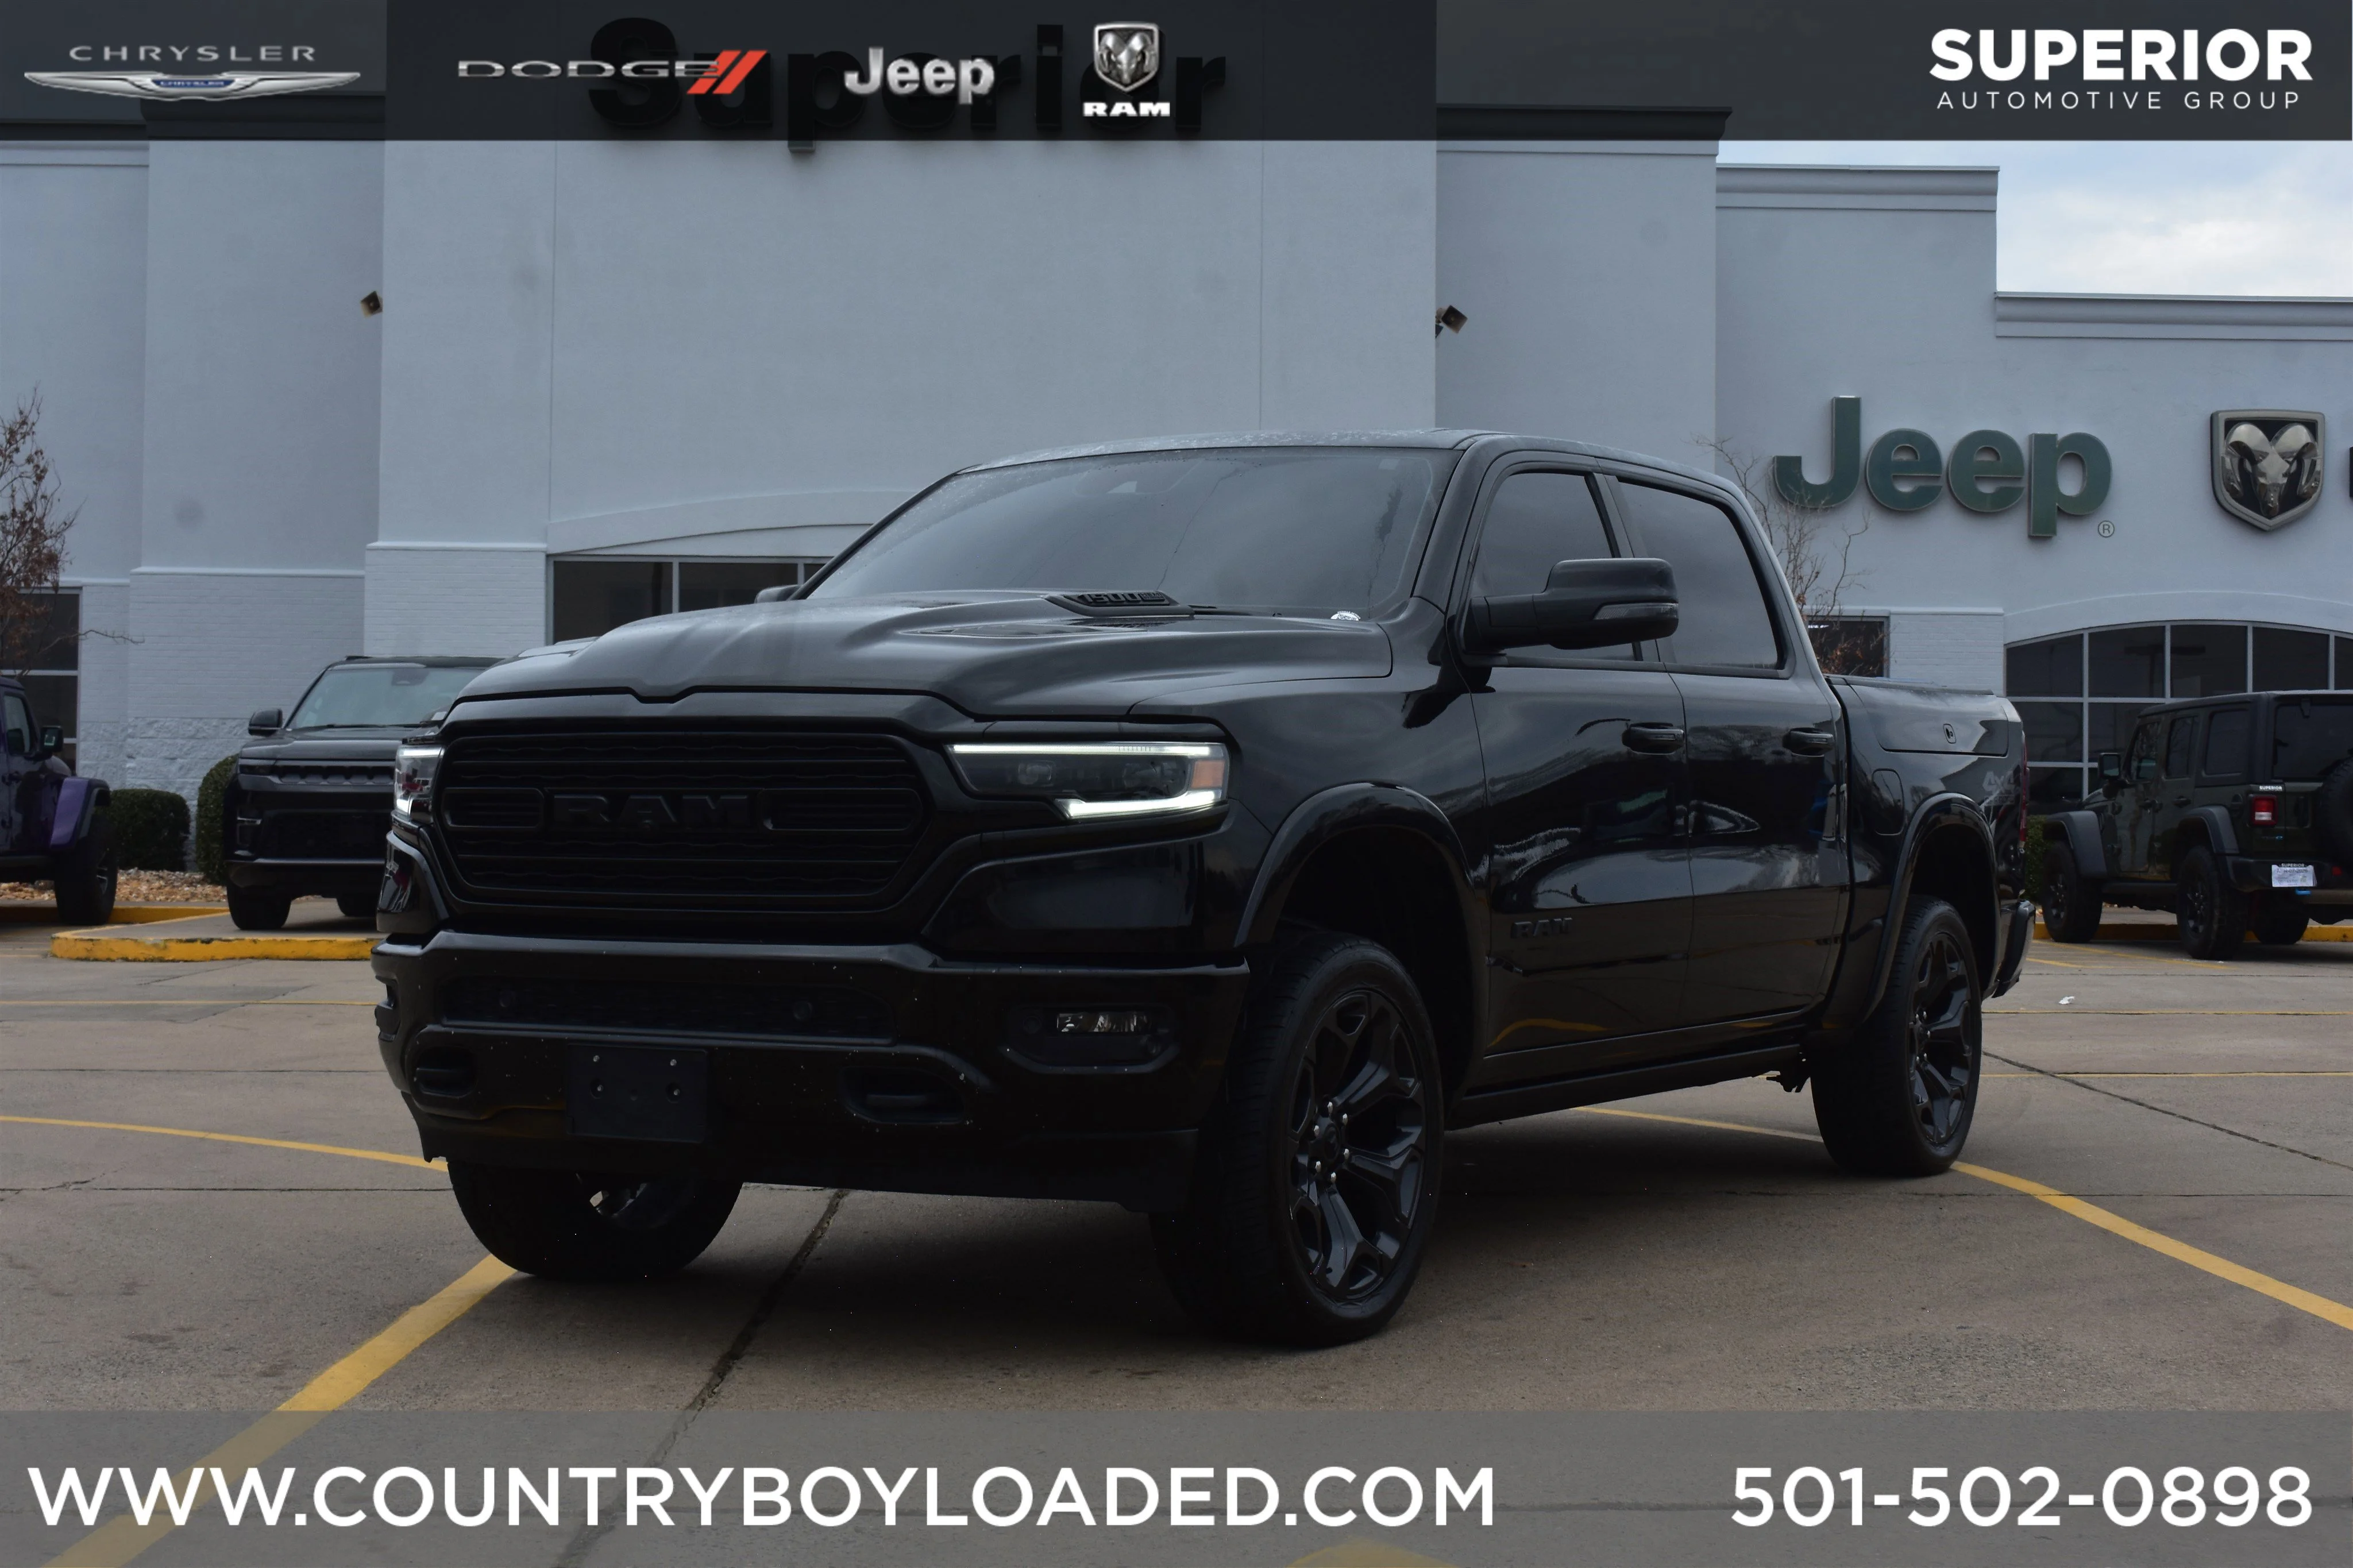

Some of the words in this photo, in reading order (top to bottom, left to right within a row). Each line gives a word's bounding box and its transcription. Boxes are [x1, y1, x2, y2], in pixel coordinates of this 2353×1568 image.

[1773, 396, 2112, 538] Jeep
[1080, 593, 1141, 603] 1500
[553, 793, 750, 826] RAM
[1510, 917, 1573, 939] RAM
